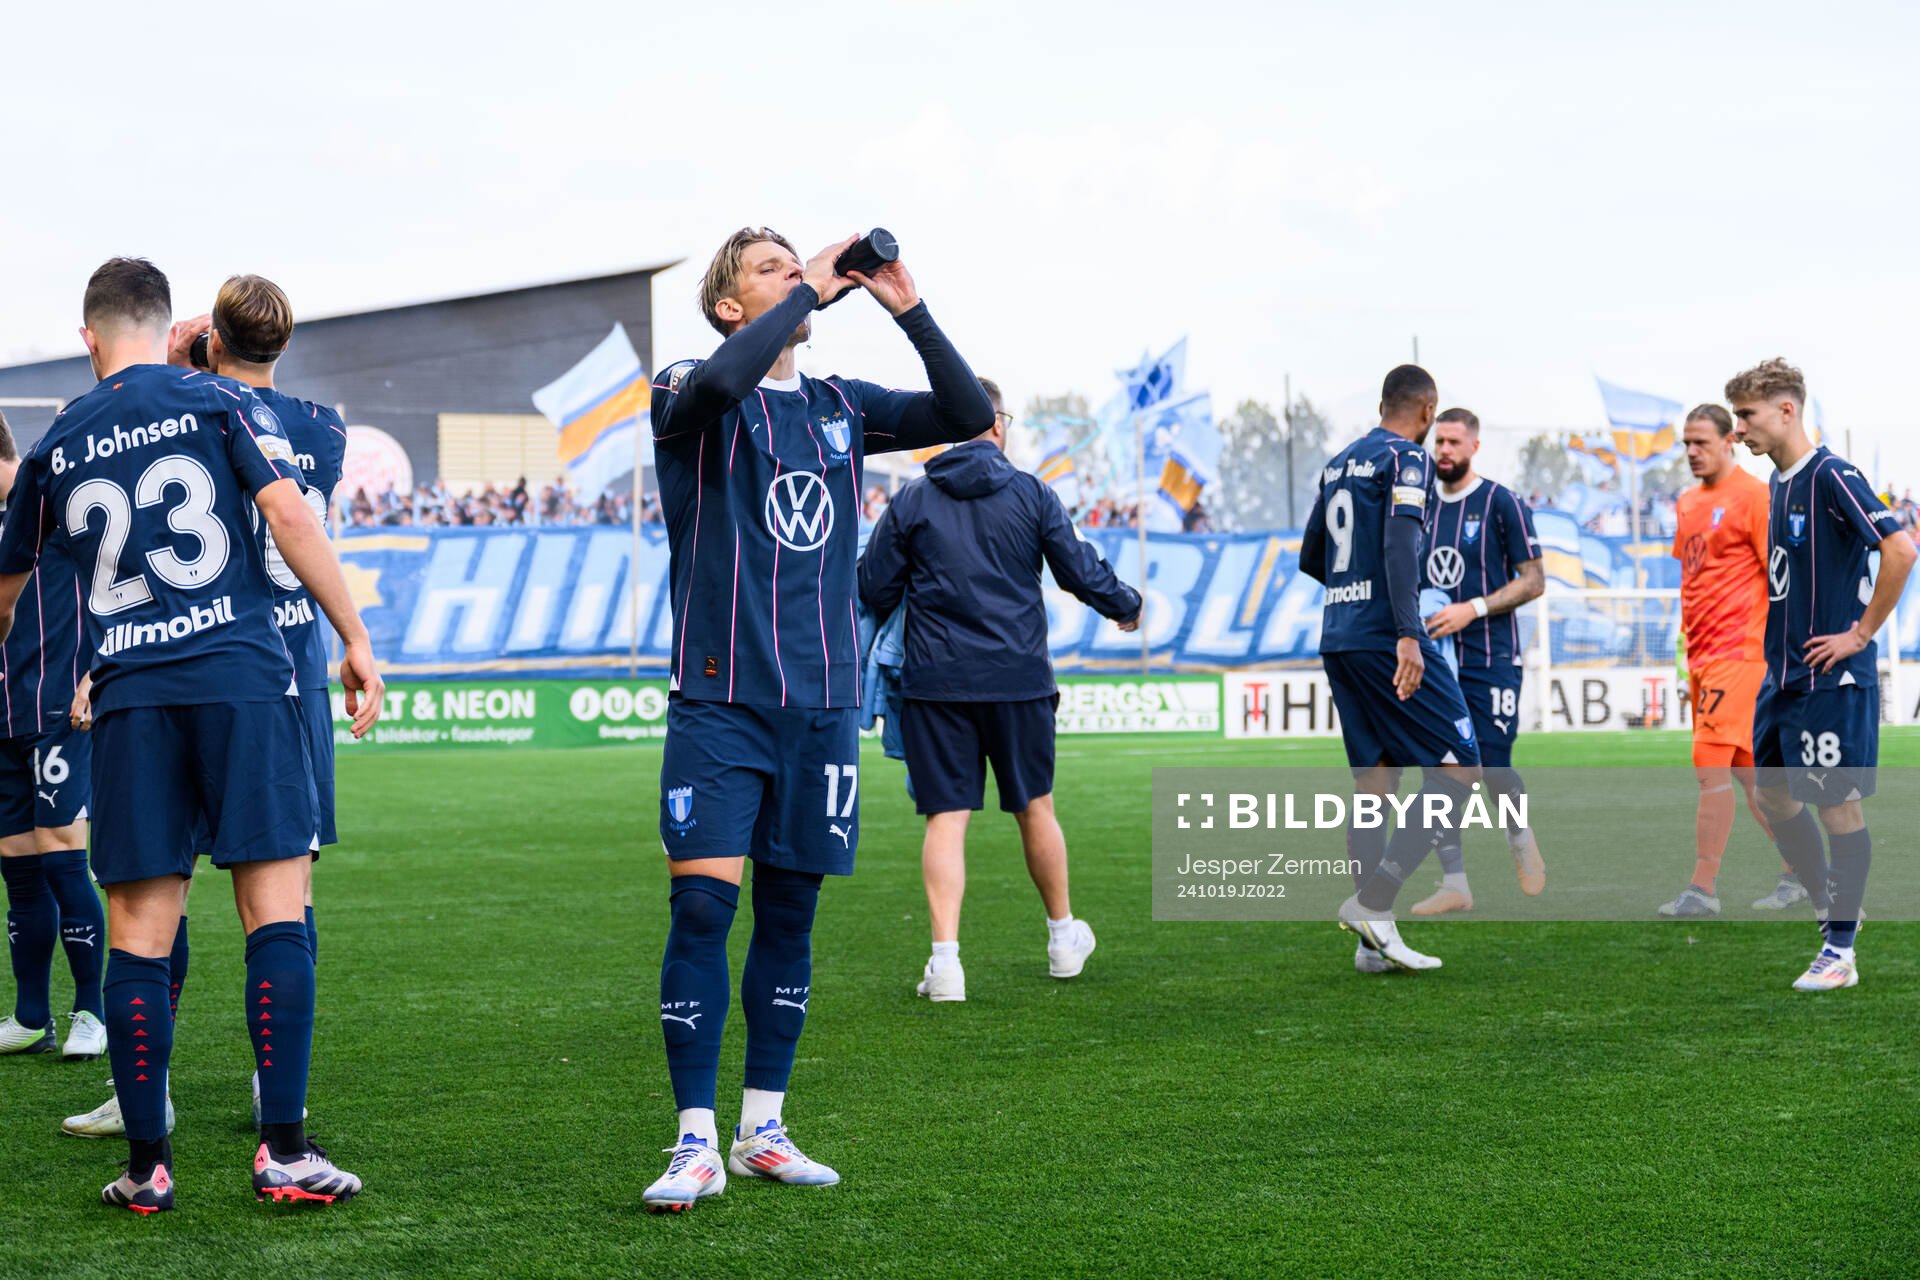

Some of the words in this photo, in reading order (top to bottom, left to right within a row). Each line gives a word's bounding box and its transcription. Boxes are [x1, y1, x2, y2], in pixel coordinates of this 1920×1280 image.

[51, 450, 75, 476] B.
[84, 412, 199, 464] Johnsen
[66, 454, 230, 616] 23
[1324, 488, 1354, 574] 9
[412, 690, 437, 721] &
[443, 689, 536, 720] NEON
[1490, 687, 1516, 717] 18
[33, 745, 70, 785] 16
[1801, 731, 1842, 767] 38
[824, 763, 858, 818] 17
